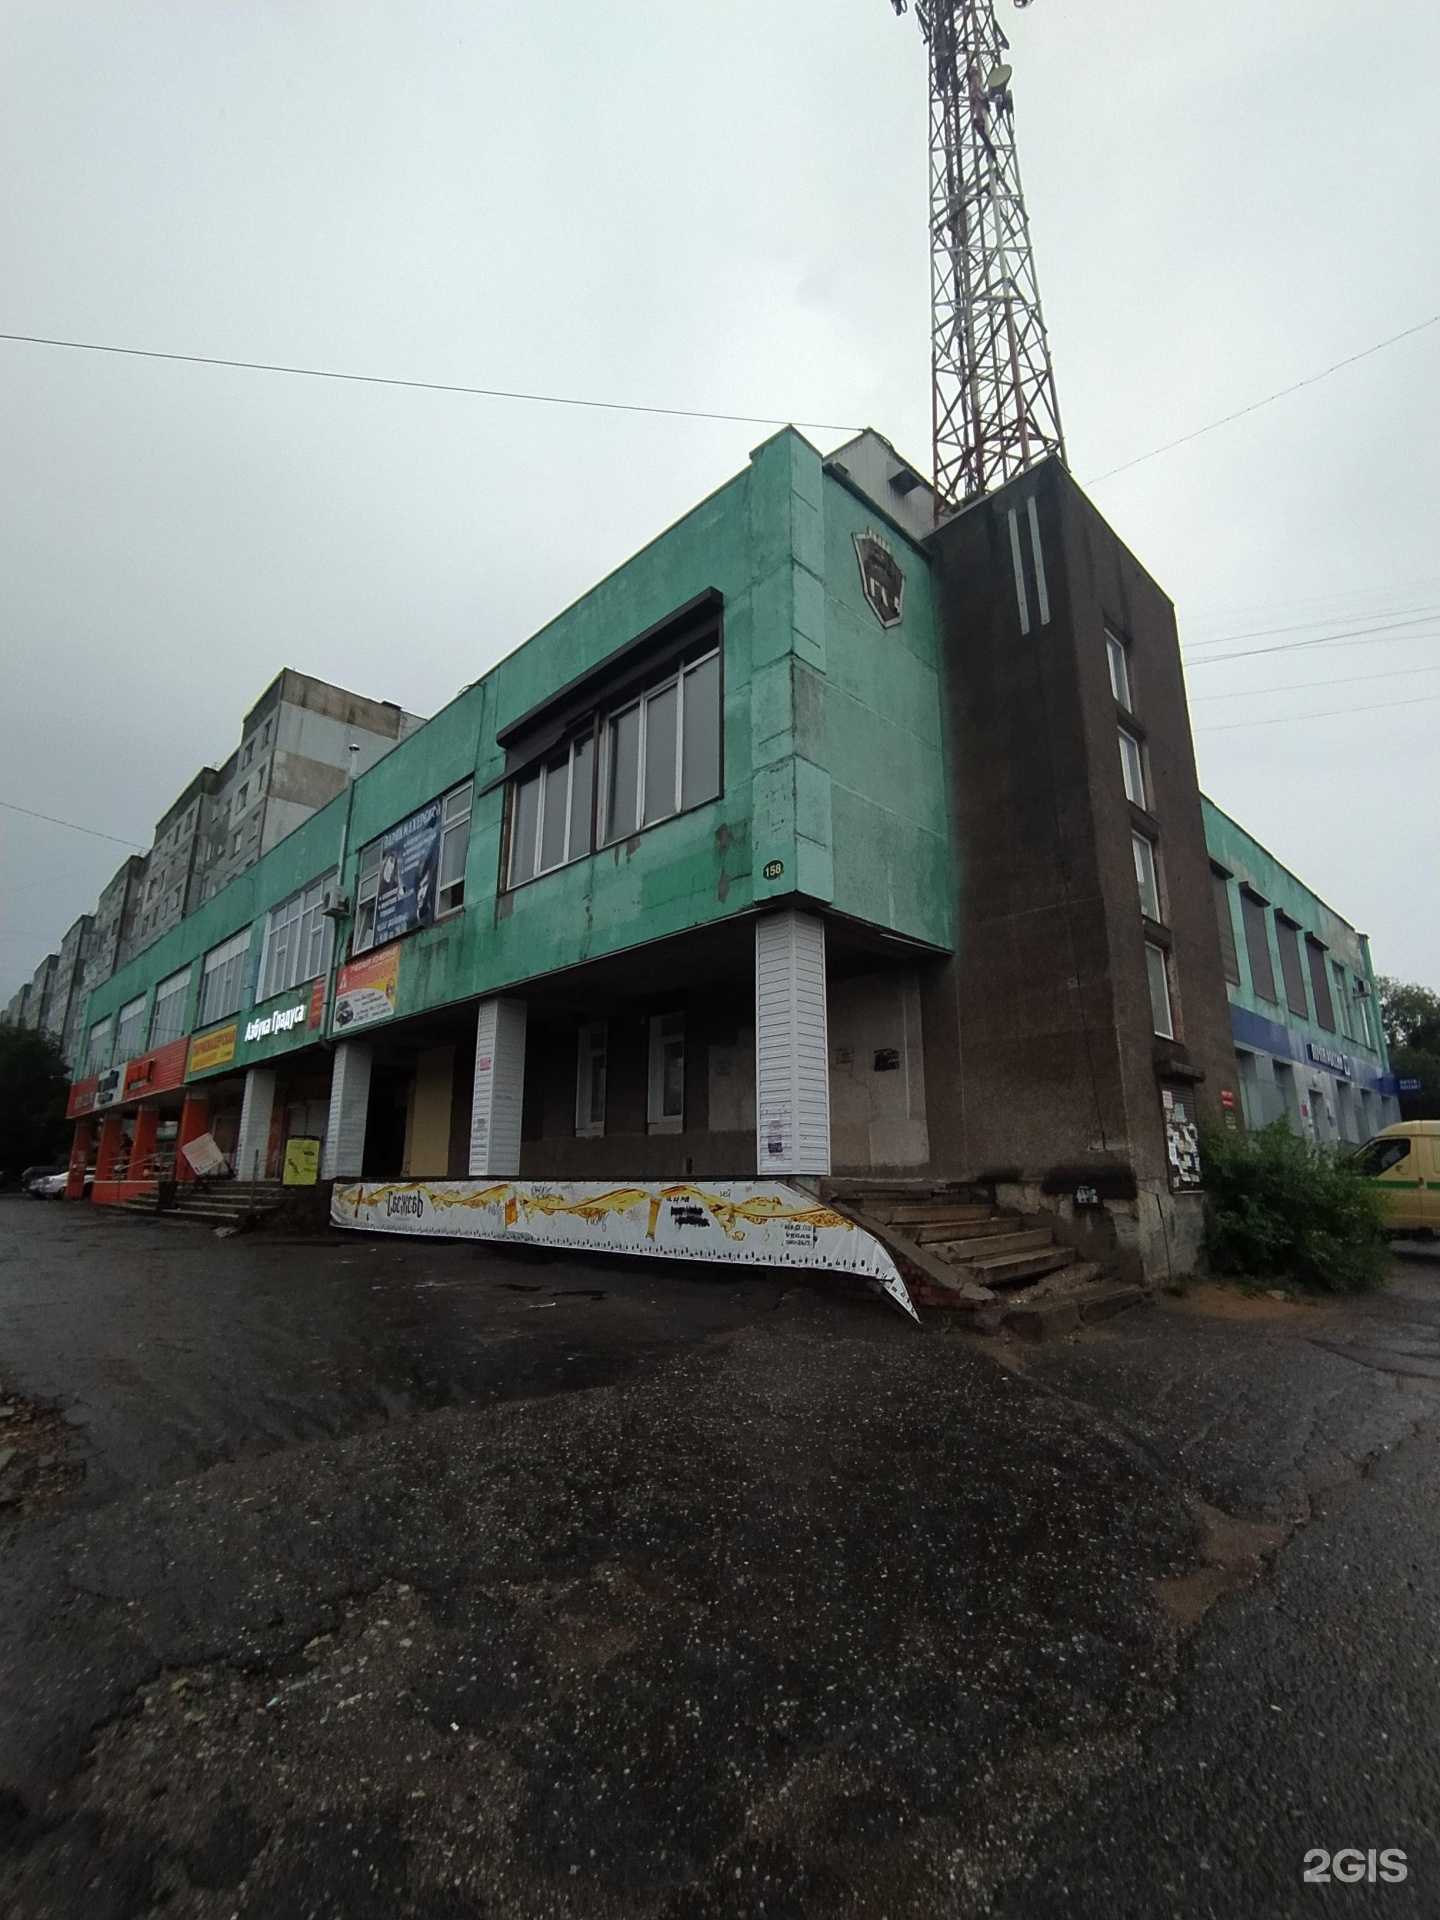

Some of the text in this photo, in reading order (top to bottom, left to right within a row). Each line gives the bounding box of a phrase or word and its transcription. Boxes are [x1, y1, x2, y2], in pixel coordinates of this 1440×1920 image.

[766, 863, 781, 877] 158
[244, 1017, 271, 1042] Азбука
[271, 1003, 305, 1035] Градуса
